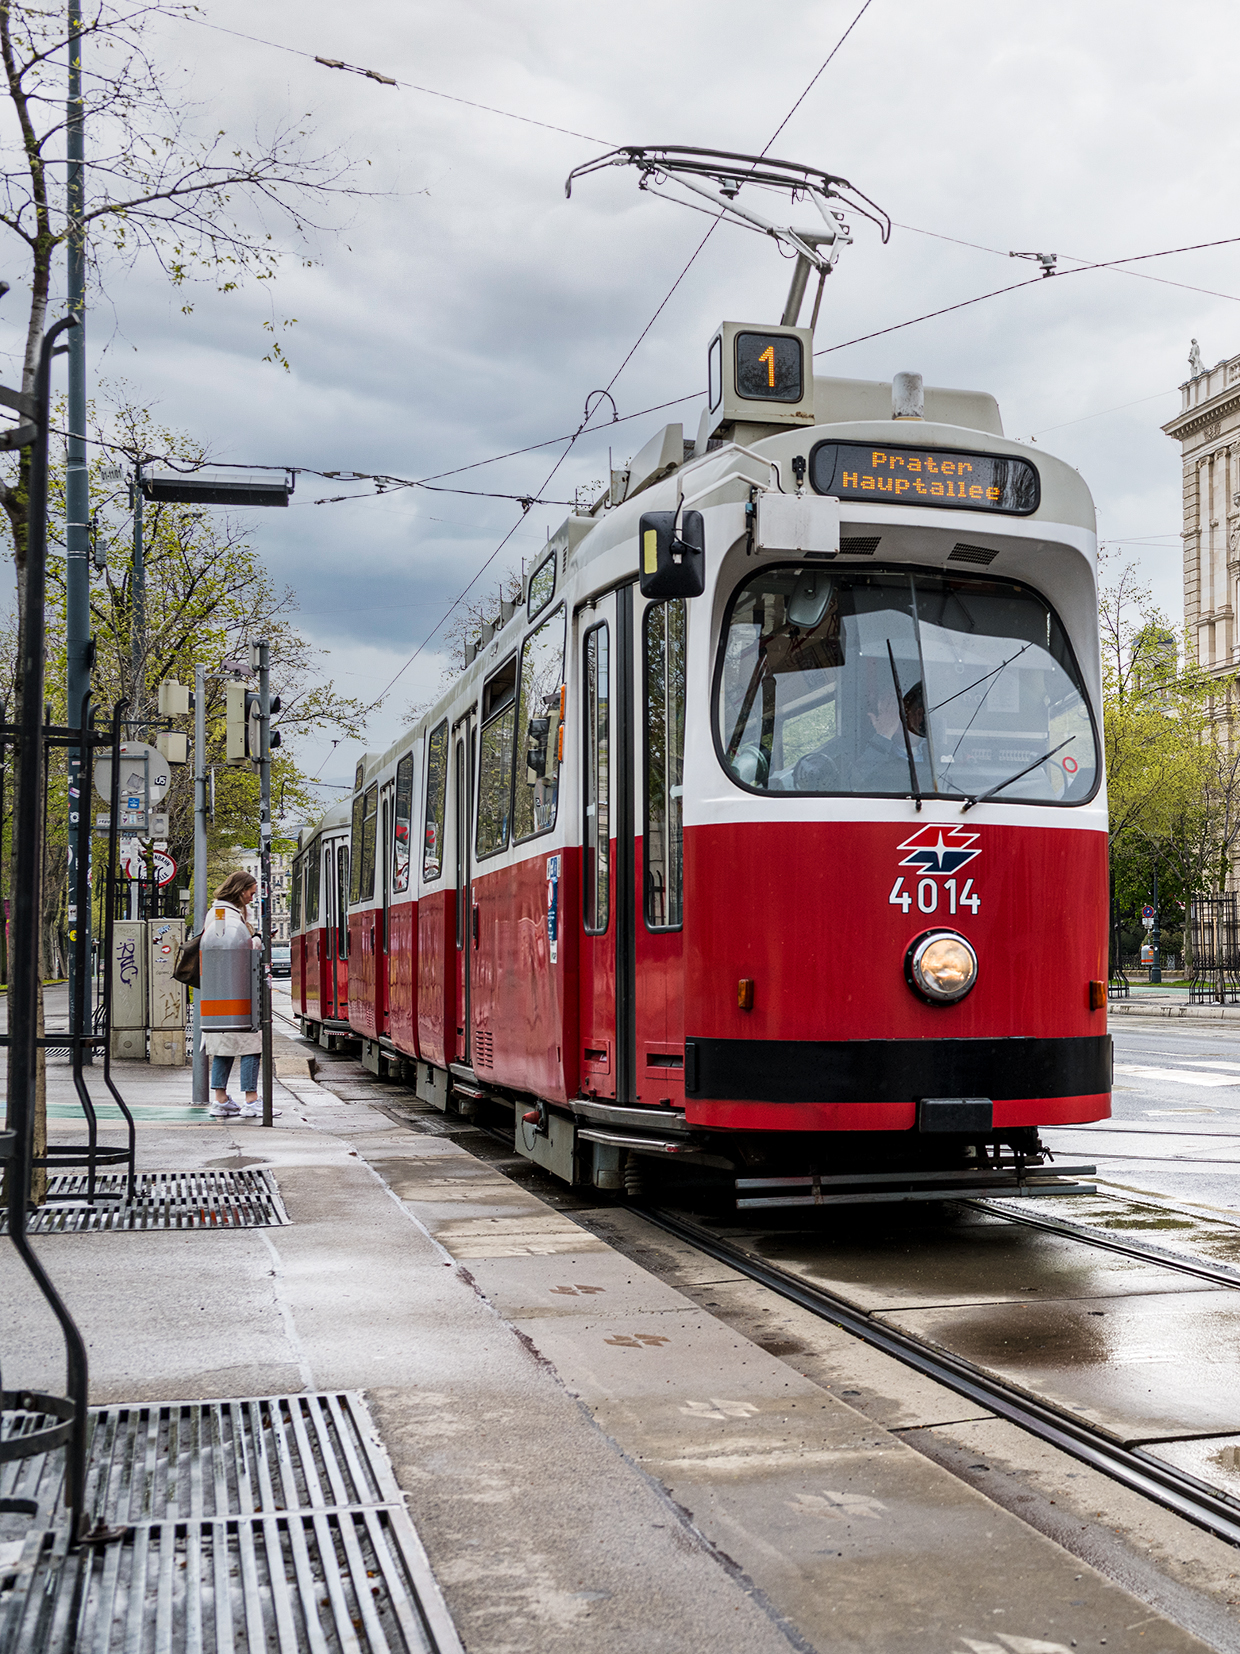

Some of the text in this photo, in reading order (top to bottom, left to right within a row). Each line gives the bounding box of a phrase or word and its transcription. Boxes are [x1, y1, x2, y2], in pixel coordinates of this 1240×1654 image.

[758, 345, 775, 388] 1
[871, 450, 973, 476] Prater
[842, 471, 1001, 502] Hauptallee
[888, 876, 982, 914] 4014
